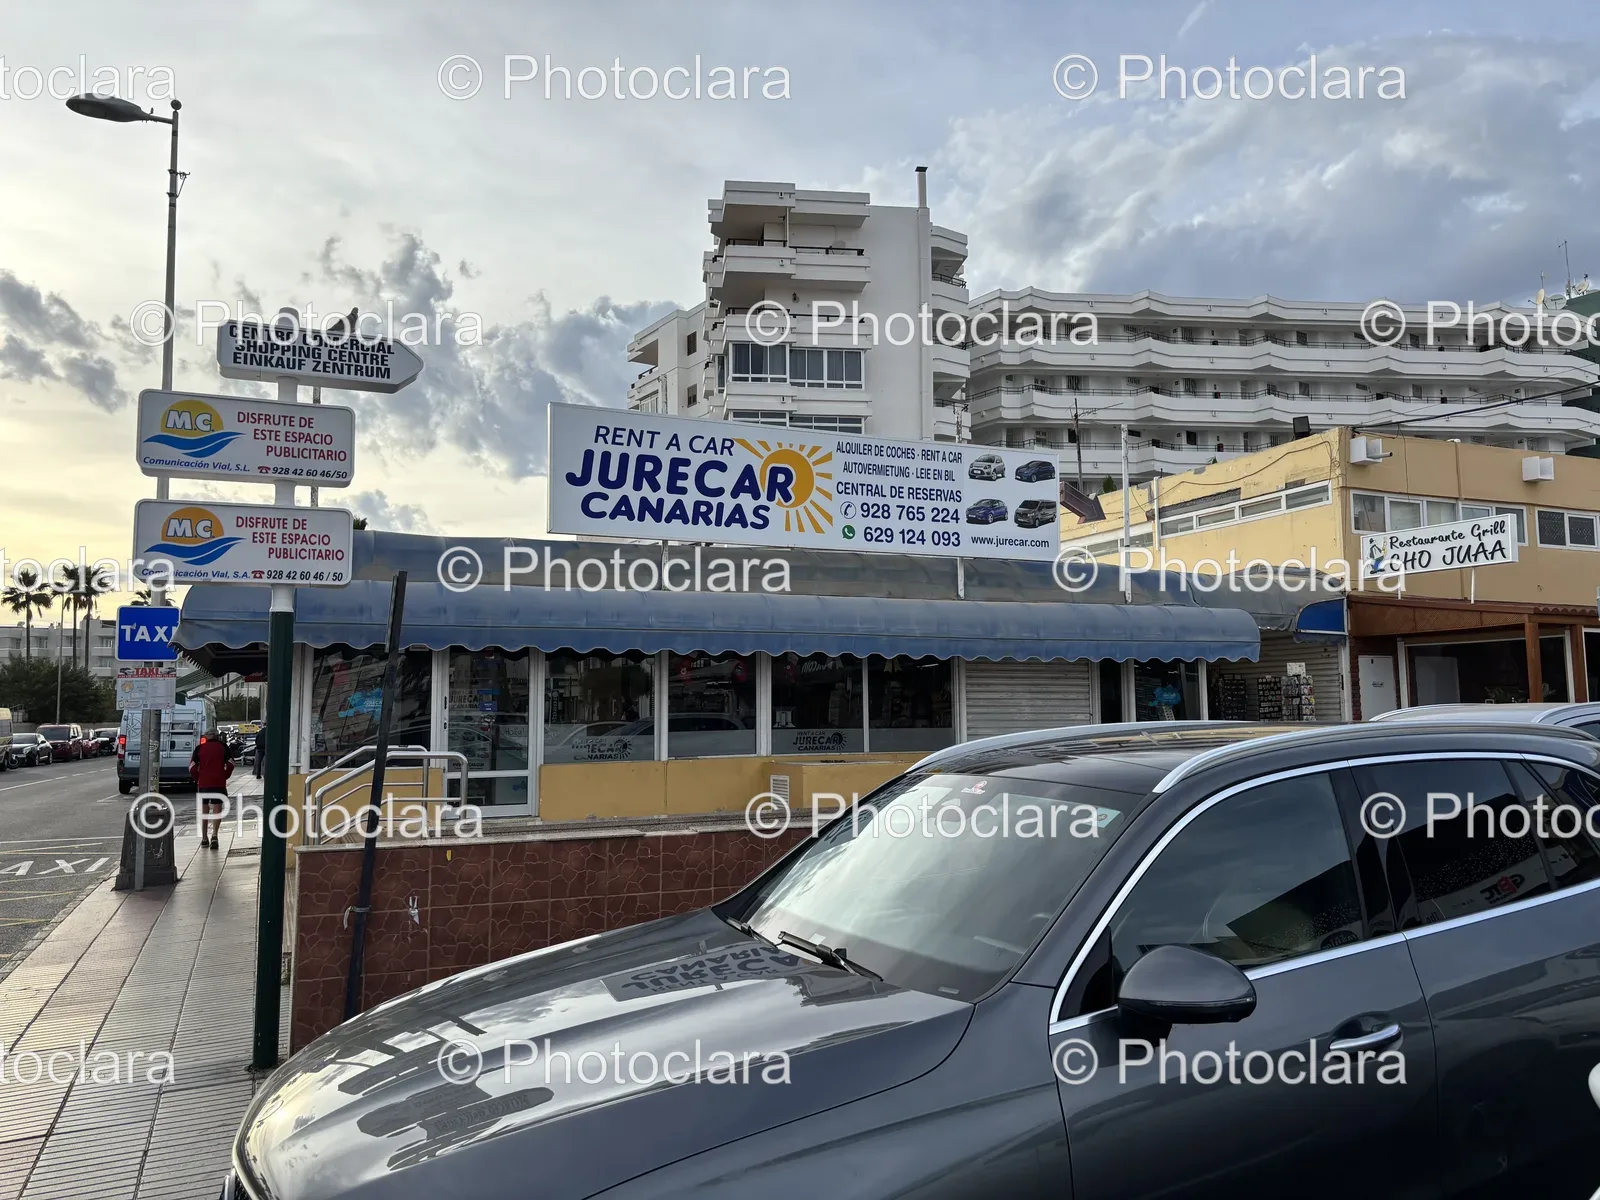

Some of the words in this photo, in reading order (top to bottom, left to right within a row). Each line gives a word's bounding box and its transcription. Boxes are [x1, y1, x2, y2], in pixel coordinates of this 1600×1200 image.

[234, 339, 322, 360] SHOPPING
[327, 350, 389, 367] CENTRE
[232, 352, 306, 371] EINKAUF
[312, 360, 391, 379] ZENTRUM
[237, 411, 295, 427] DISFRUTE
[298, 416, 314, 429] DE
[253, 428, 281, 442] ESTE
[284, 431, 333, 446] ESPACIO
[593, 425, 661, 449] RENT
[665, 433, 682, 452] A
[688, 435, 735, 457] CAR
[266, 445, 347, 462] PUBLICITARIO
[836, 441, 873, 456] ALQUILER
[874, 444, 884, 457] DE
[886, 446, 916, 460] COCHES
[921, 449, 940, 462] RENT
[941, 451, 947, 463] A
[948, 451, 963, 464] CAR
[143, 456, 209, 469] Comunicación
[212, 461, 232, 471] Vial,
[234, 463, 250, 472] S.L.
[271, 466, 290, 475] 928
[291, 467, 304, 476] 42
[305, 468, 318, 477] 60
[319, 469, 348, 479] 46/50
[843, 461, 910, 478] AUTOVERMIETUNG
[915, 467, 931, 480] LEIE
[933, 468, 943, 481] EN
[944, 470, 956, 482] BIL
[565, 448, 795, 503] JURECAR
[836, 481, 887, 498] CENTRAL
[889, 485, 905, 499] DE
[907, 486, 962, 503] RESERVAS
[580, 491, 770, 530] CANARIAS
[860, 502, 891, 519] 928
[896, 504, 926, 522] 765
[930, 506, 960, 524] 224
[236, 516, 288, 529] DISFRUTE
[292, 518, 307, 530] DE
[252, 532, 277, 544] ESTE
[281, 533, 331, 545] ESPACIO
[863, 526, 894, 544] 629
[898, 528, 926, 546] 124
[931, 530, 961, 547] 093
[971, 535, 1050, 548] www.jurecar.com
[1389, 530, 1465, 549] Restaurante
[1470, 520, 1506, 541] Grill
[268, 547, 344, 561] PUBLICITARIO
[1389, 550, 1432, 572] CHO
[1442, 539, 1507, 565] JUAA
[141, 568, 208, 578] Comicación
[211, 570, 230, 579] Vial,
[232, 571, 250, 579] S.A.
[266, 570, 284, 580] 928
[285, 570, 297, 580] 42
[299, 571, 311, 581] 60
[313, 571, 324, 581] 46
[331, 572, 343, 582] 50
[135, 667, 160, 675] TAXI
[793, 736, 840, 745] JURECAR
